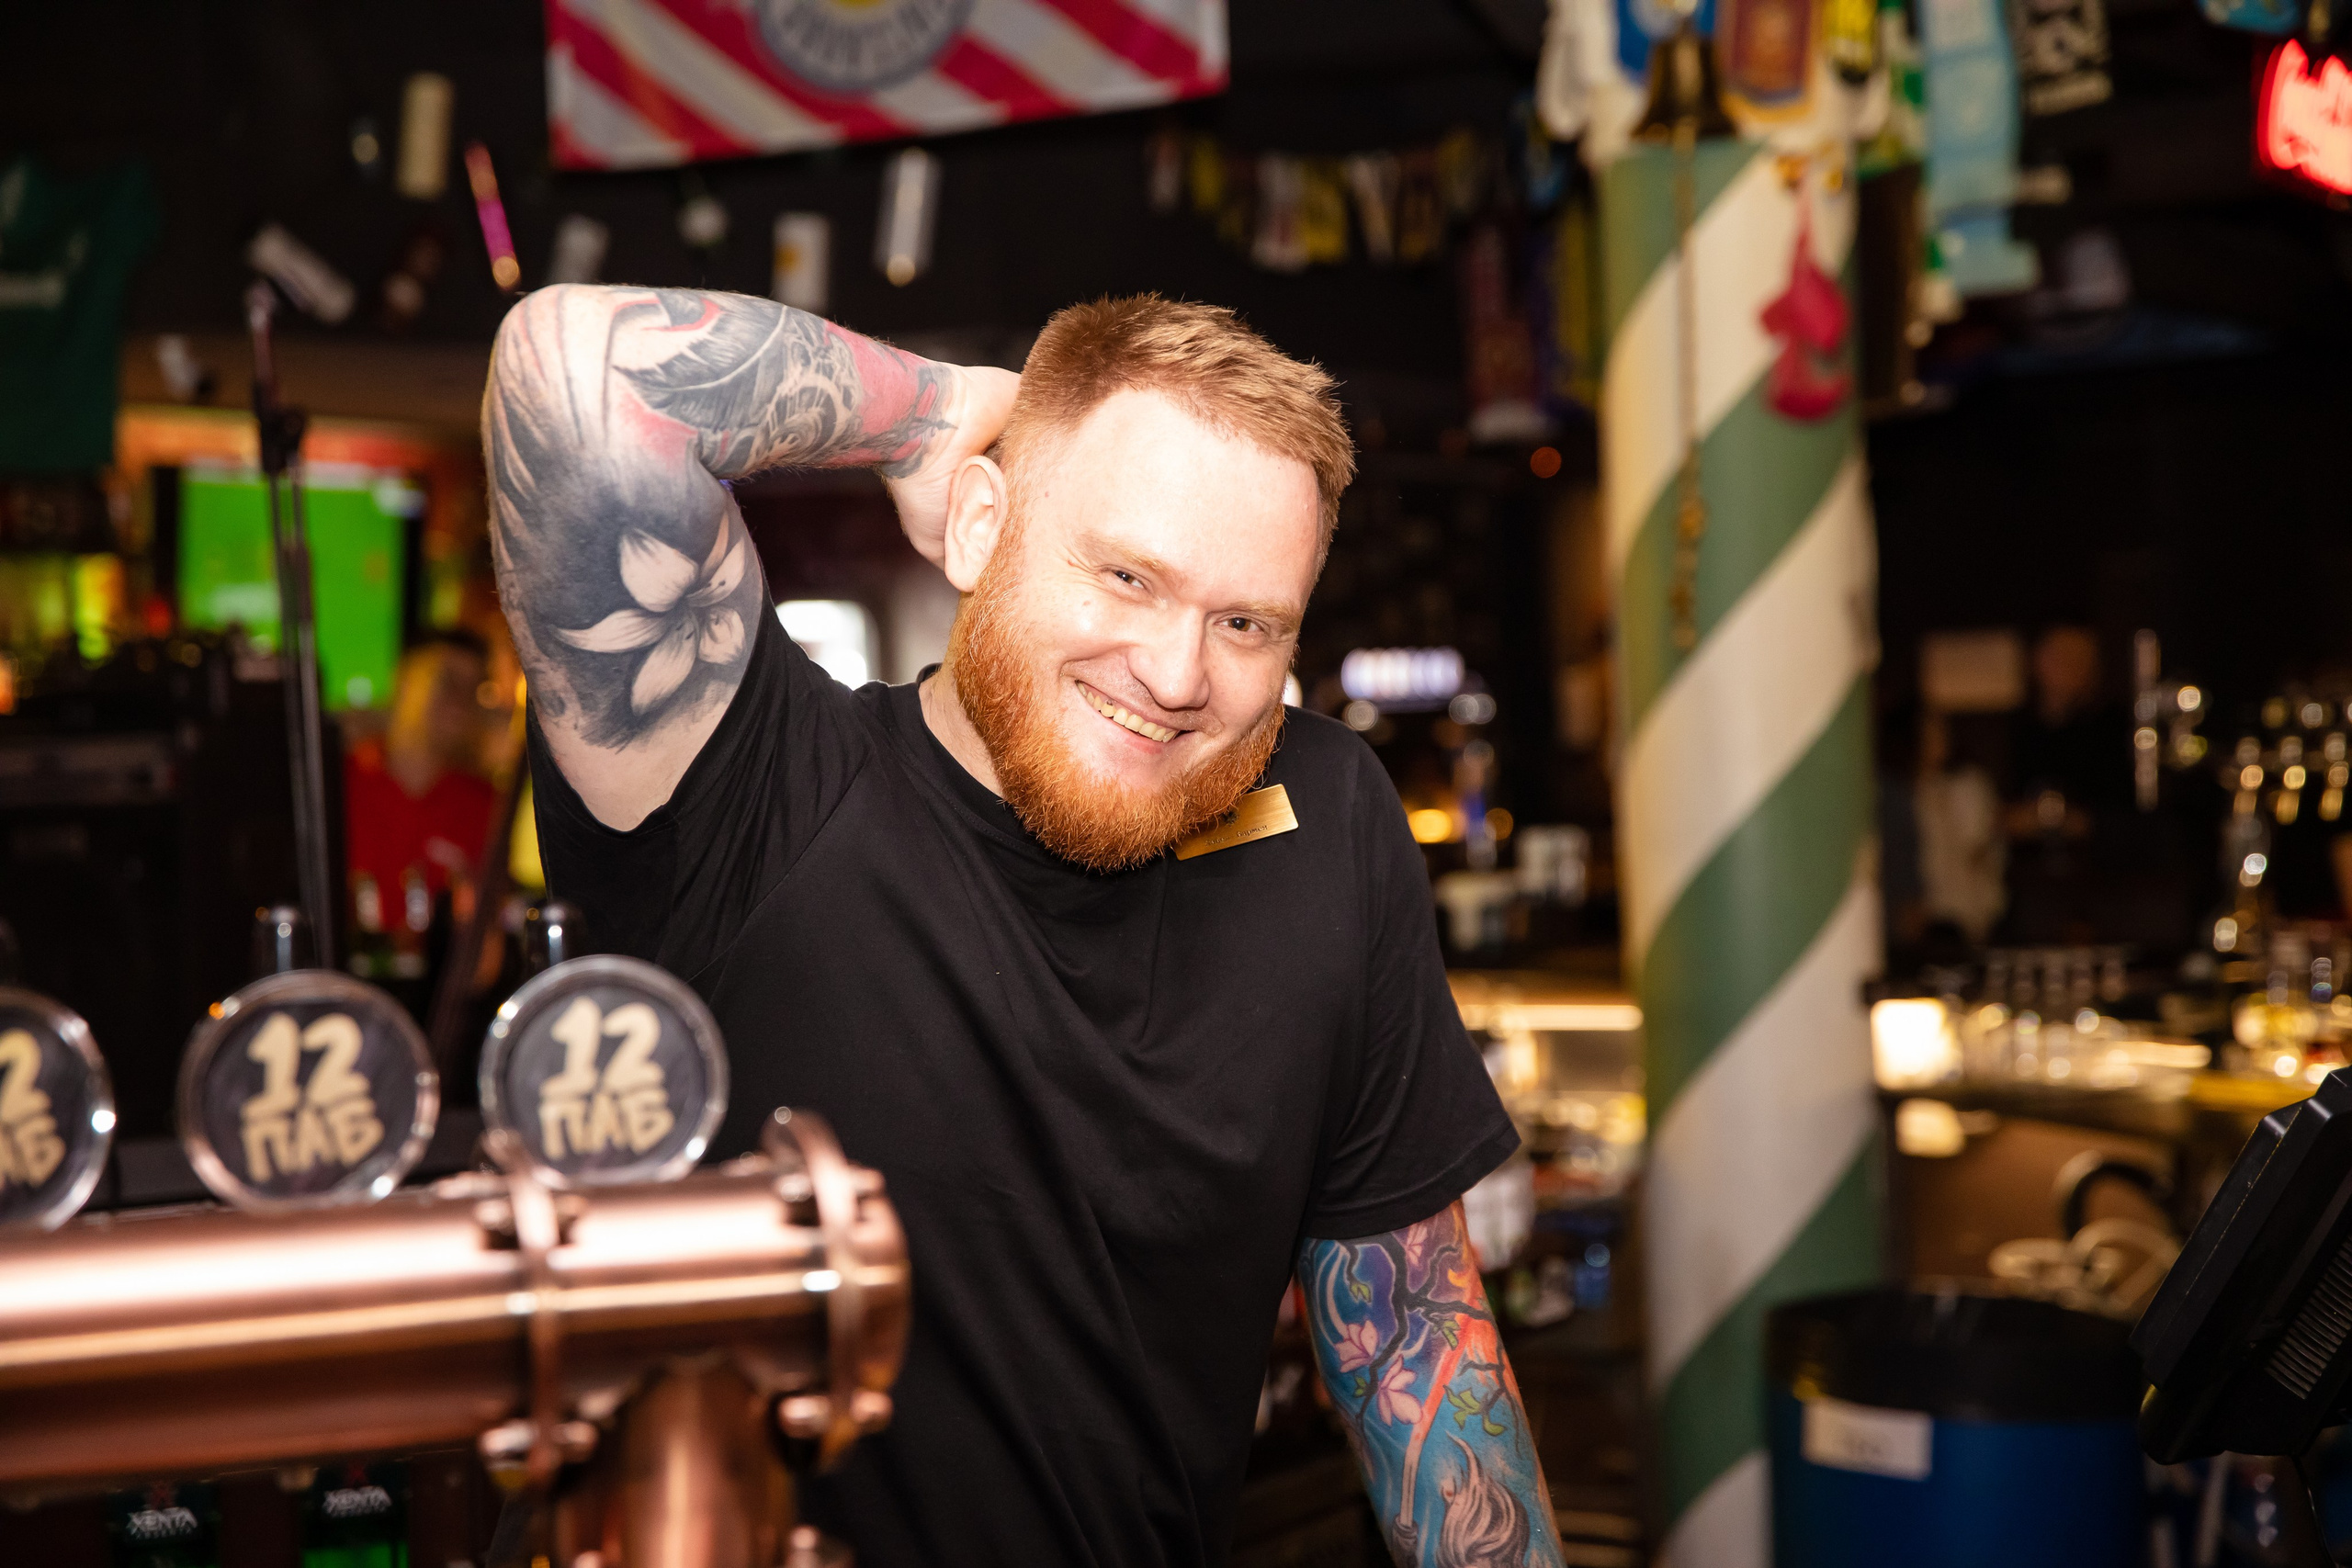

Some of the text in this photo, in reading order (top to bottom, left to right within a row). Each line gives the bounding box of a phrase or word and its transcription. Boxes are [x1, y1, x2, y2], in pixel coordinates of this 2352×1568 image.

[241, 1012, 370, 1117] 12
[540, 995, 664, 1095] 12
[240, 1097, 385, 1184] ПАБ
[538, 1089, 675, 1161] ПАБ
